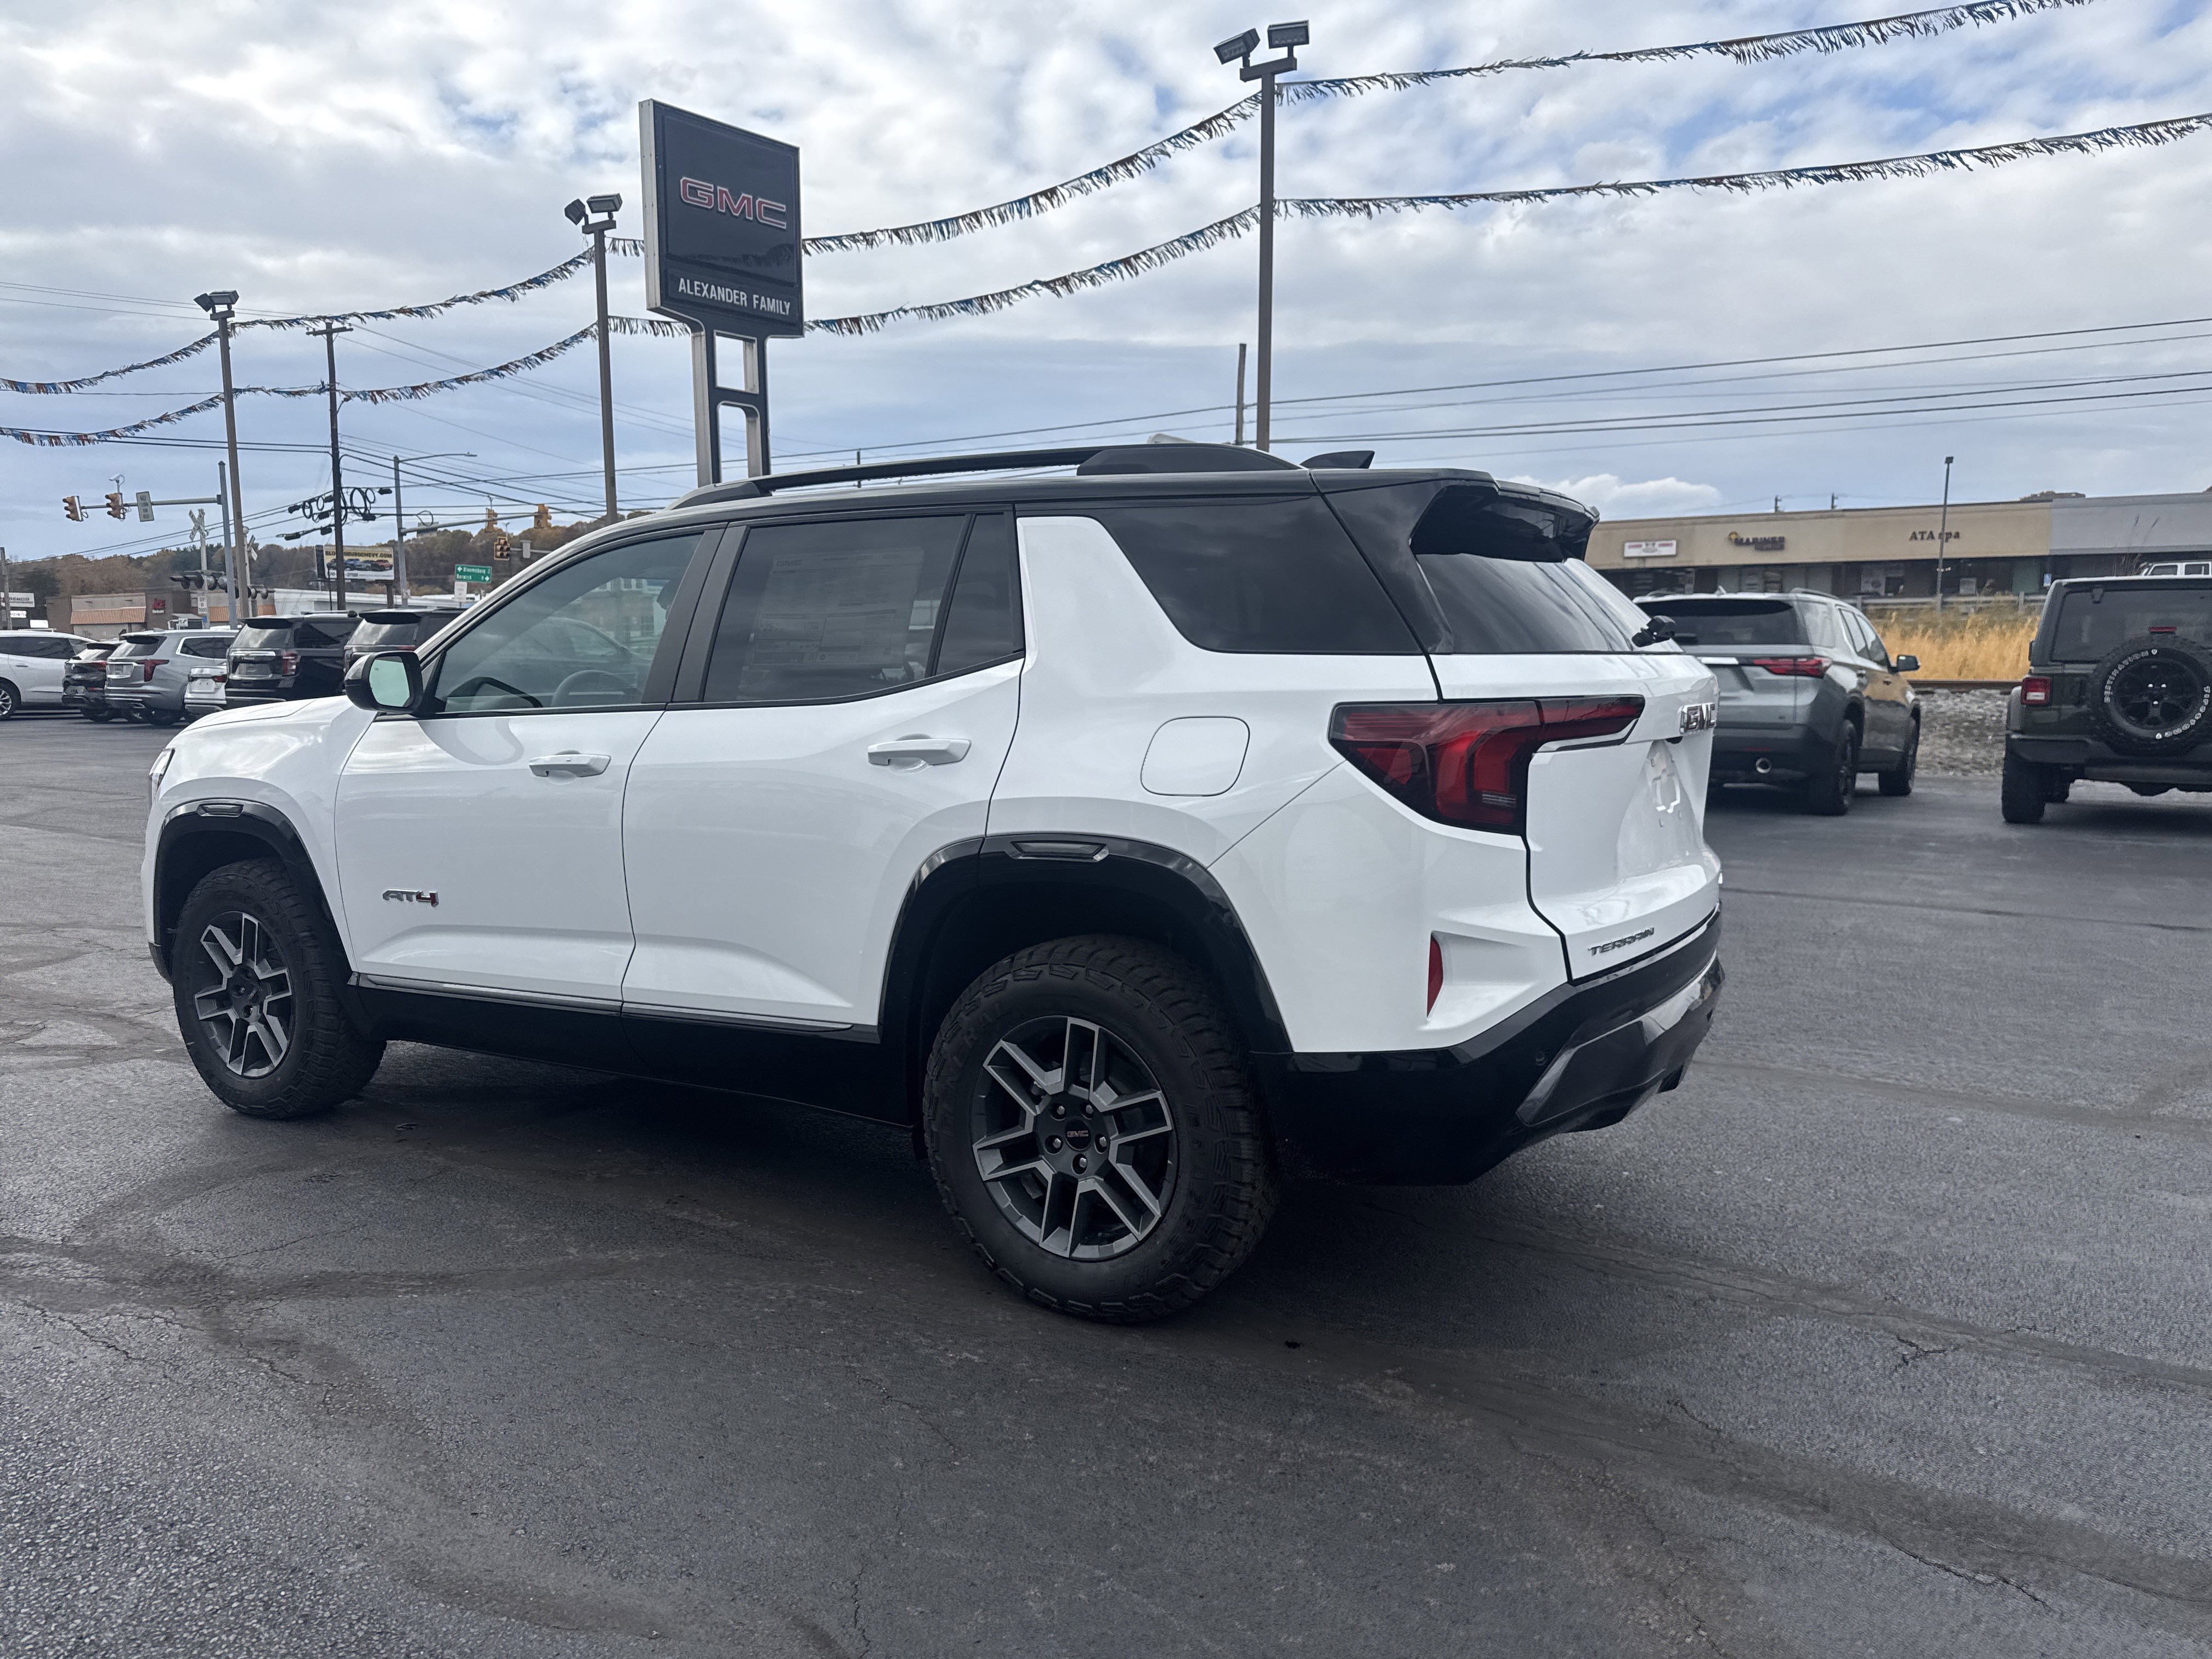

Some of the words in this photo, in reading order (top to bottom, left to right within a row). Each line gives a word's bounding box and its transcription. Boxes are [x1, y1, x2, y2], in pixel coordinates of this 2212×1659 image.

[680, 177, 786, 229] GMC
[679, 278, 747, 307] ALEXANDER
[753, 294, 791, 315] FAMILY
[1909, 531, 1935, 541] ATA
[382, 889, 439, 907] AT4
[1587, 927, 1655, 956] TERRAIN
